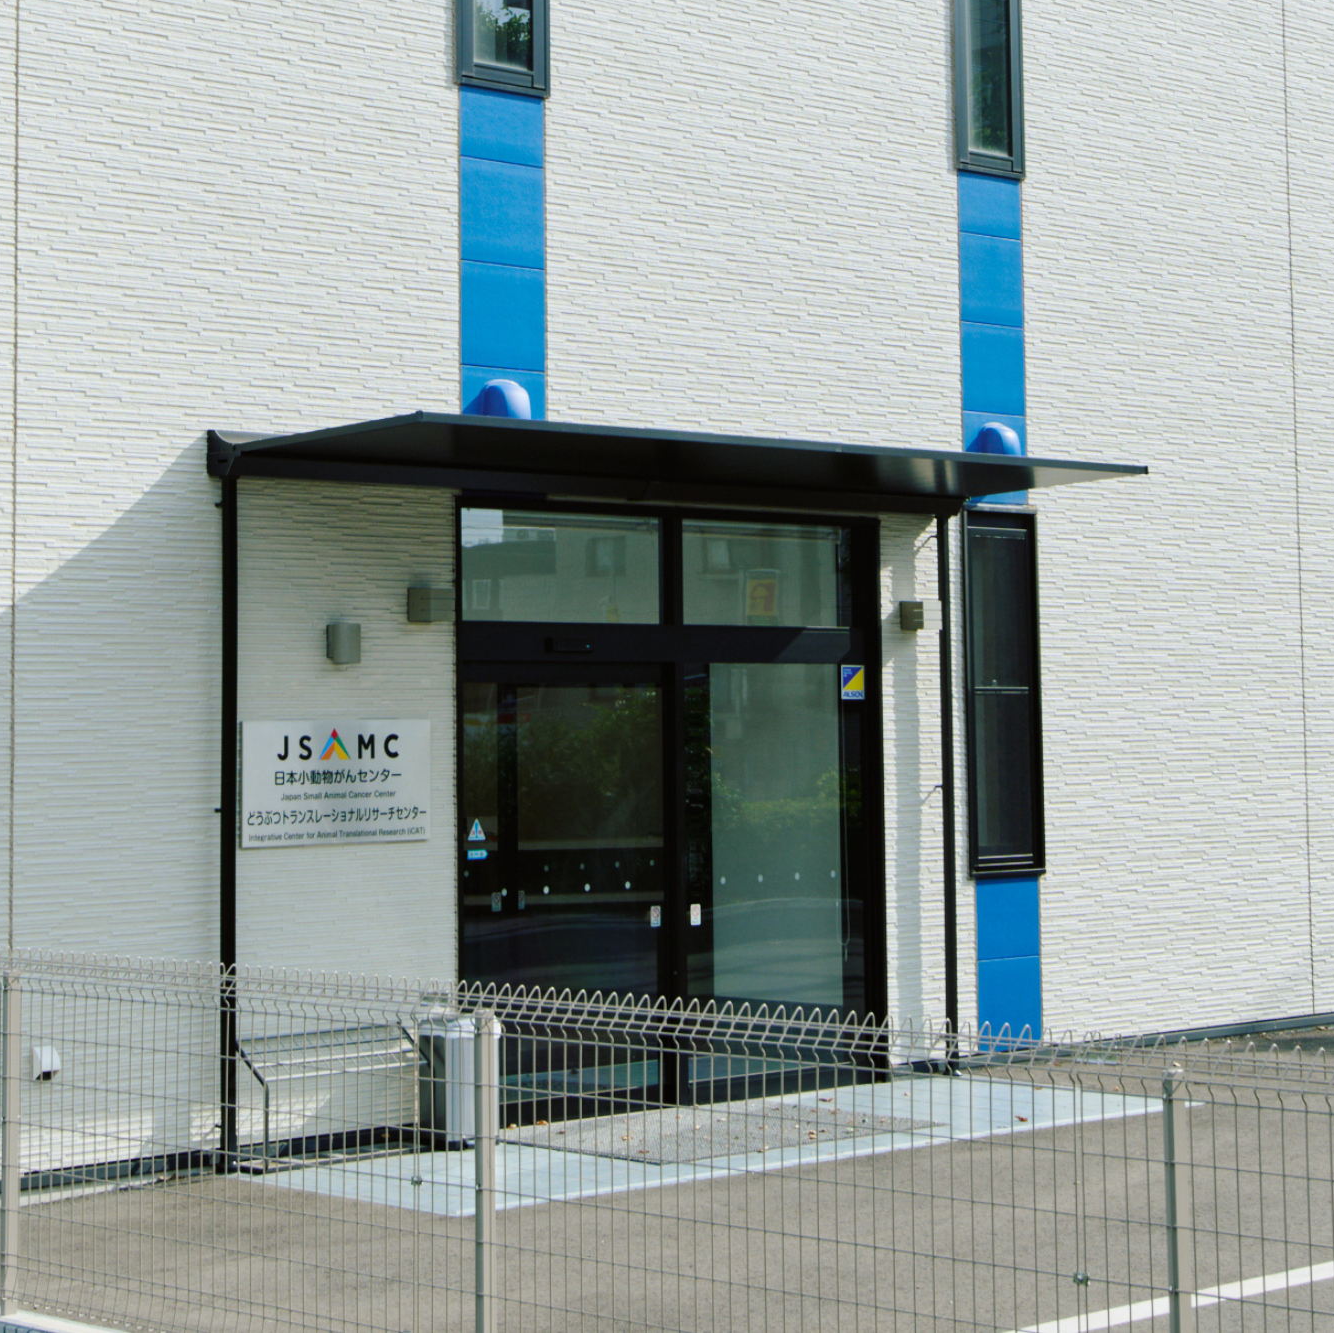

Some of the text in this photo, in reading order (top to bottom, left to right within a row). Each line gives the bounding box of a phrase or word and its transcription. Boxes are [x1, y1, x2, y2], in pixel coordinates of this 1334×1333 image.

[277, 728, 400, 761] JSAMC
[274, 770, 402, 786] 日本小動物がんセンター
[281, 789, 396, 801] Japan Small Animal Cancer Center
[247, 807, 427, 826] どうぶつトランスレーショナルリサーチセンター
[249, 833, 282, 842] Integrative
[284, 832, 305, 840] Center
[306, 831, 315, 839] for
[317, 830, 338, 839] Animal
[339, 828, 378, 838] Translational
[379, 827, 405, 836] Research
